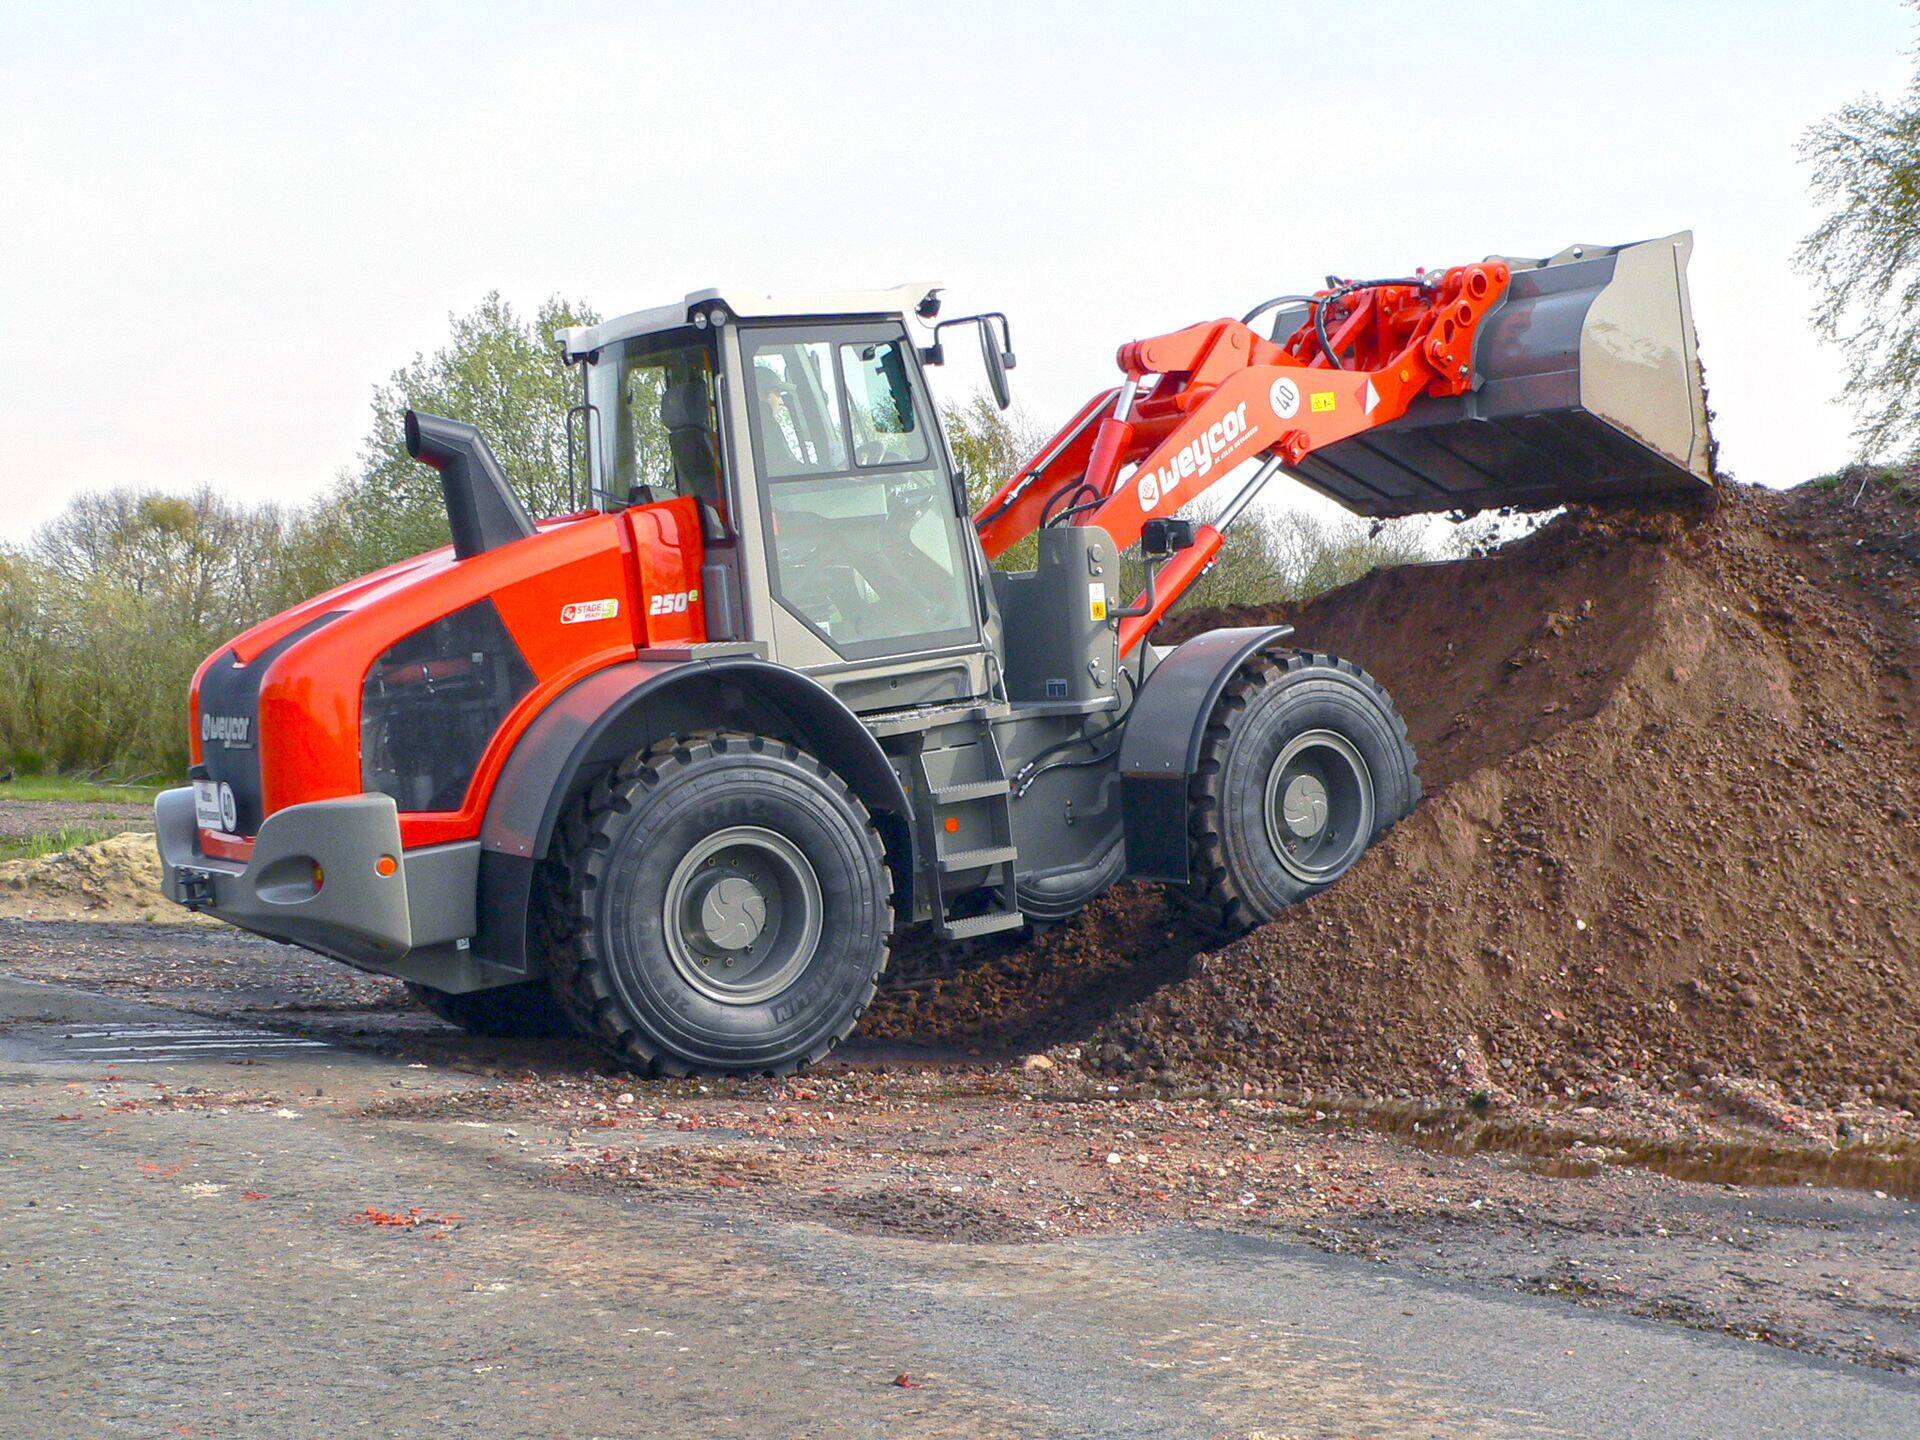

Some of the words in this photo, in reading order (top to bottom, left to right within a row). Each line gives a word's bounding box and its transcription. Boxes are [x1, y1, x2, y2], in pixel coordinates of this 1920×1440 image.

[1275, 385, 1294, 411] 40
[1158, 401, 1247, 496] weycor
[577, 603, 602, 614] STAGE
[210, 717, 250, 748] weycor
